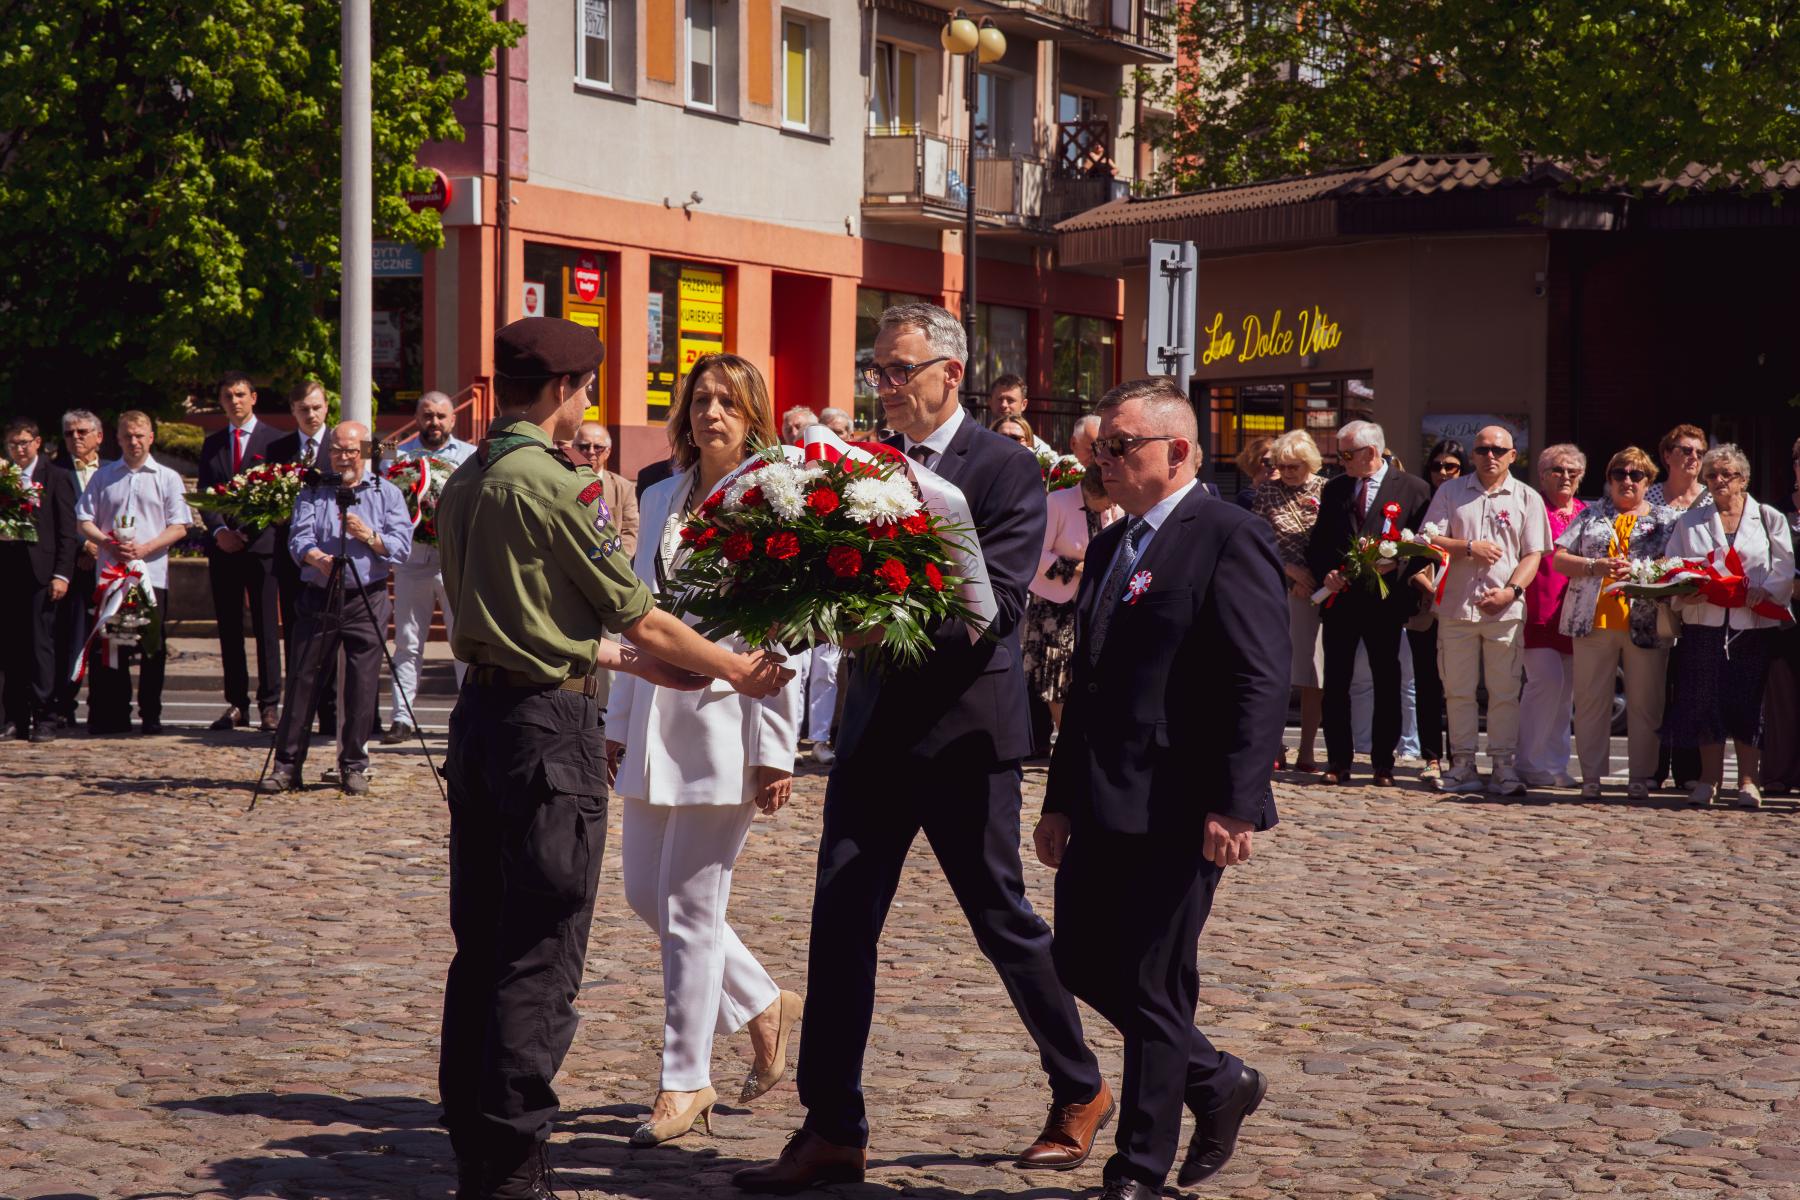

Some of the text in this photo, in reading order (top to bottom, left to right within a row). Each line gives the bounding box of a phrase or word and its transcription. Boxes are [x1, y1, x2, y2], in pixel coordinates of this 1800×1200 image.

[1202, 304, 1343, 365] La Dolce Vita
